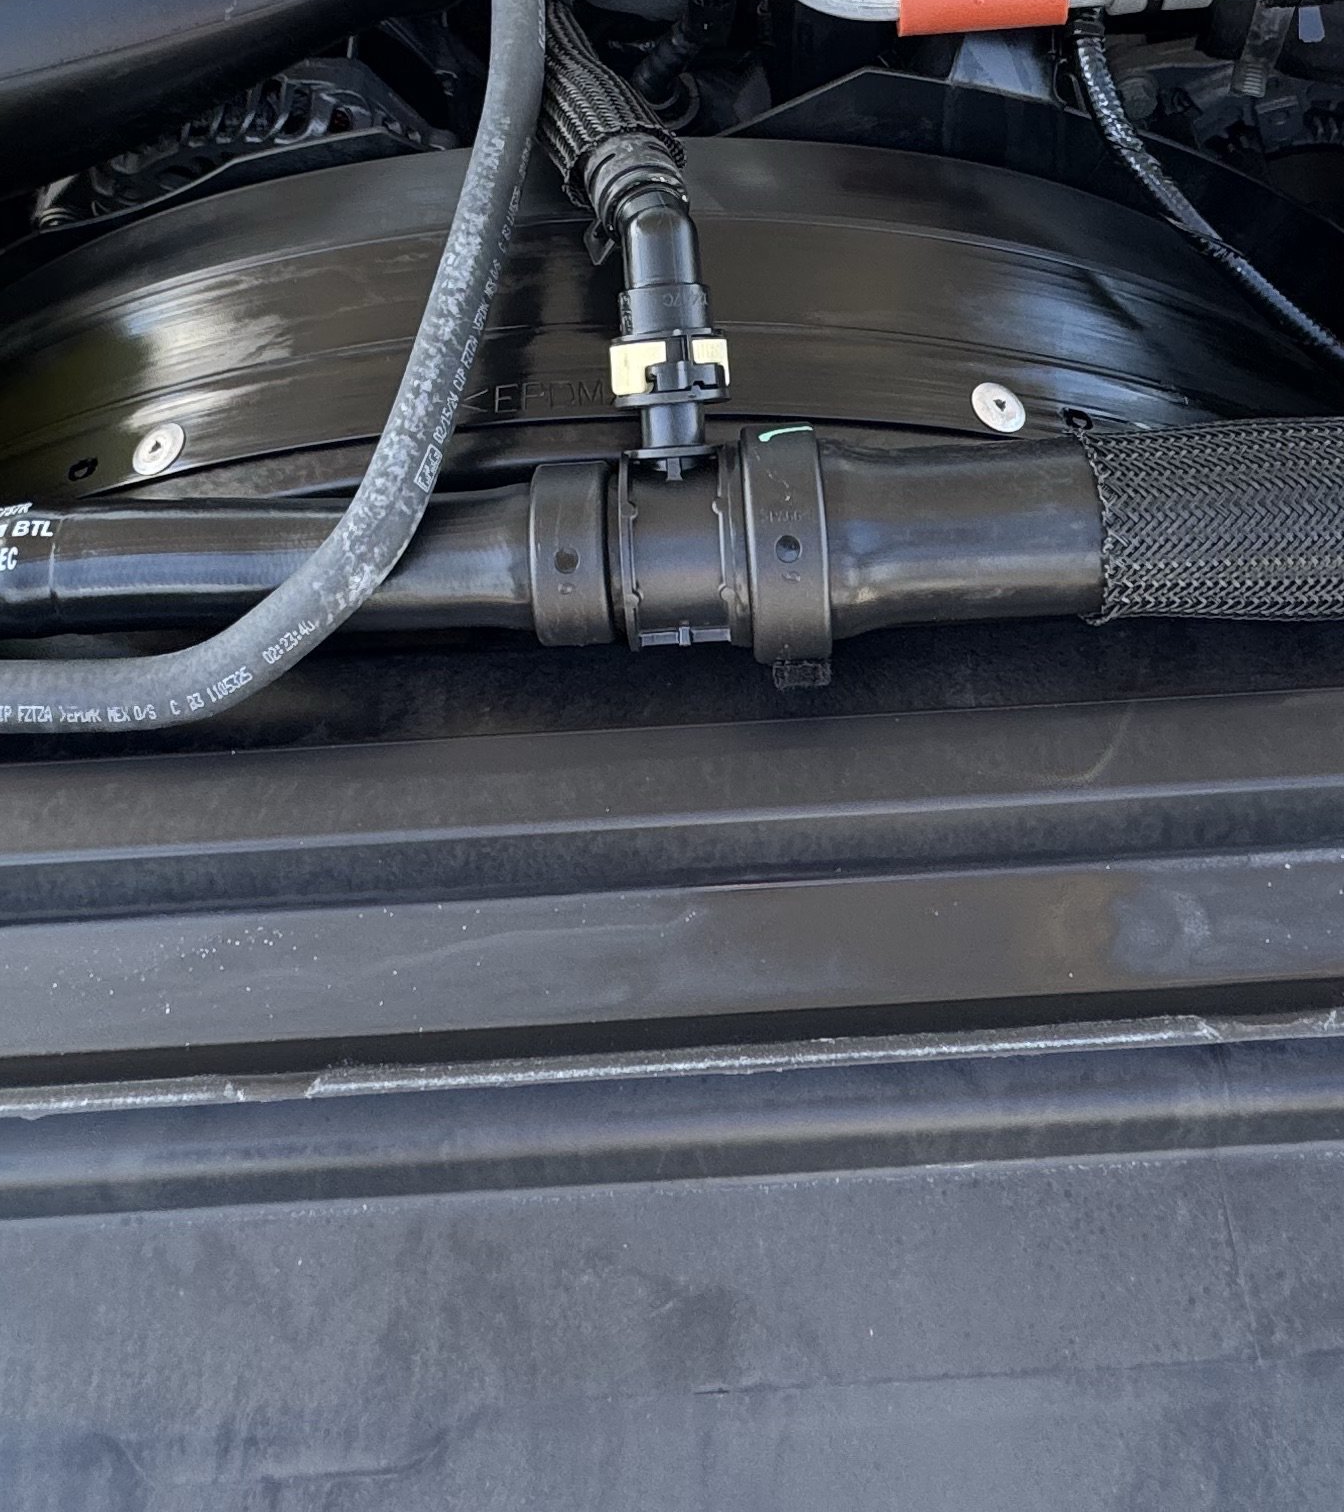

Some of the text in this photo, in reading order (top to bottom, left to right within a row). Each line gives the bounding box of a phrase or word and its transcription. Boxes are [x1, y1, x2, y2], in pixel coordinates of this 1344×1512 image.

[432, 390, 459, 445] 02/15/24
[11, 520, 54, 537] BTL
[169, 699, 182, 716] C
[206, 666, 254, 703] 1105325
[262, 619, 317, 665] 02:23:40
